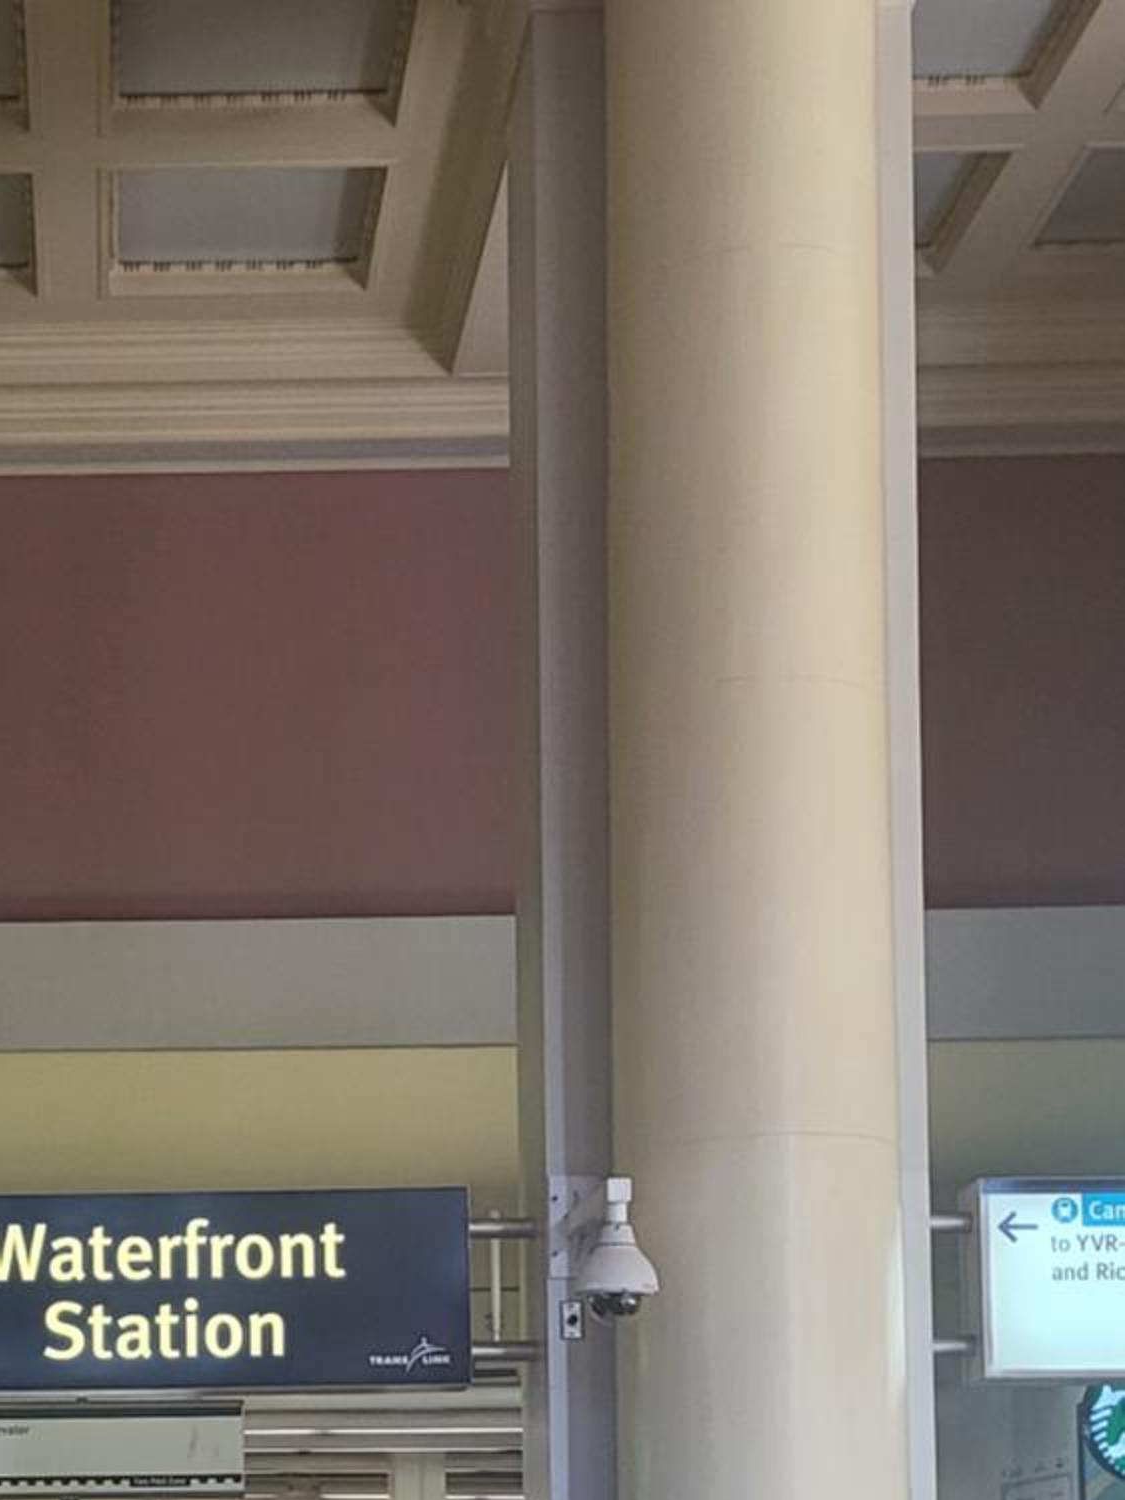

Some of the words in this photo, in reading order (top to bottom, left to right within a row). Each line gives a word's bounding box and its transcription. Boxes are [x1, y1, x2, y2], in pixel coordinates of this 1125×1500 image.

[1050, 1235, 1071, 1253] to
[1051, 1261, 1089, 1281] and
[42, 1297, 286, 1360] Station
